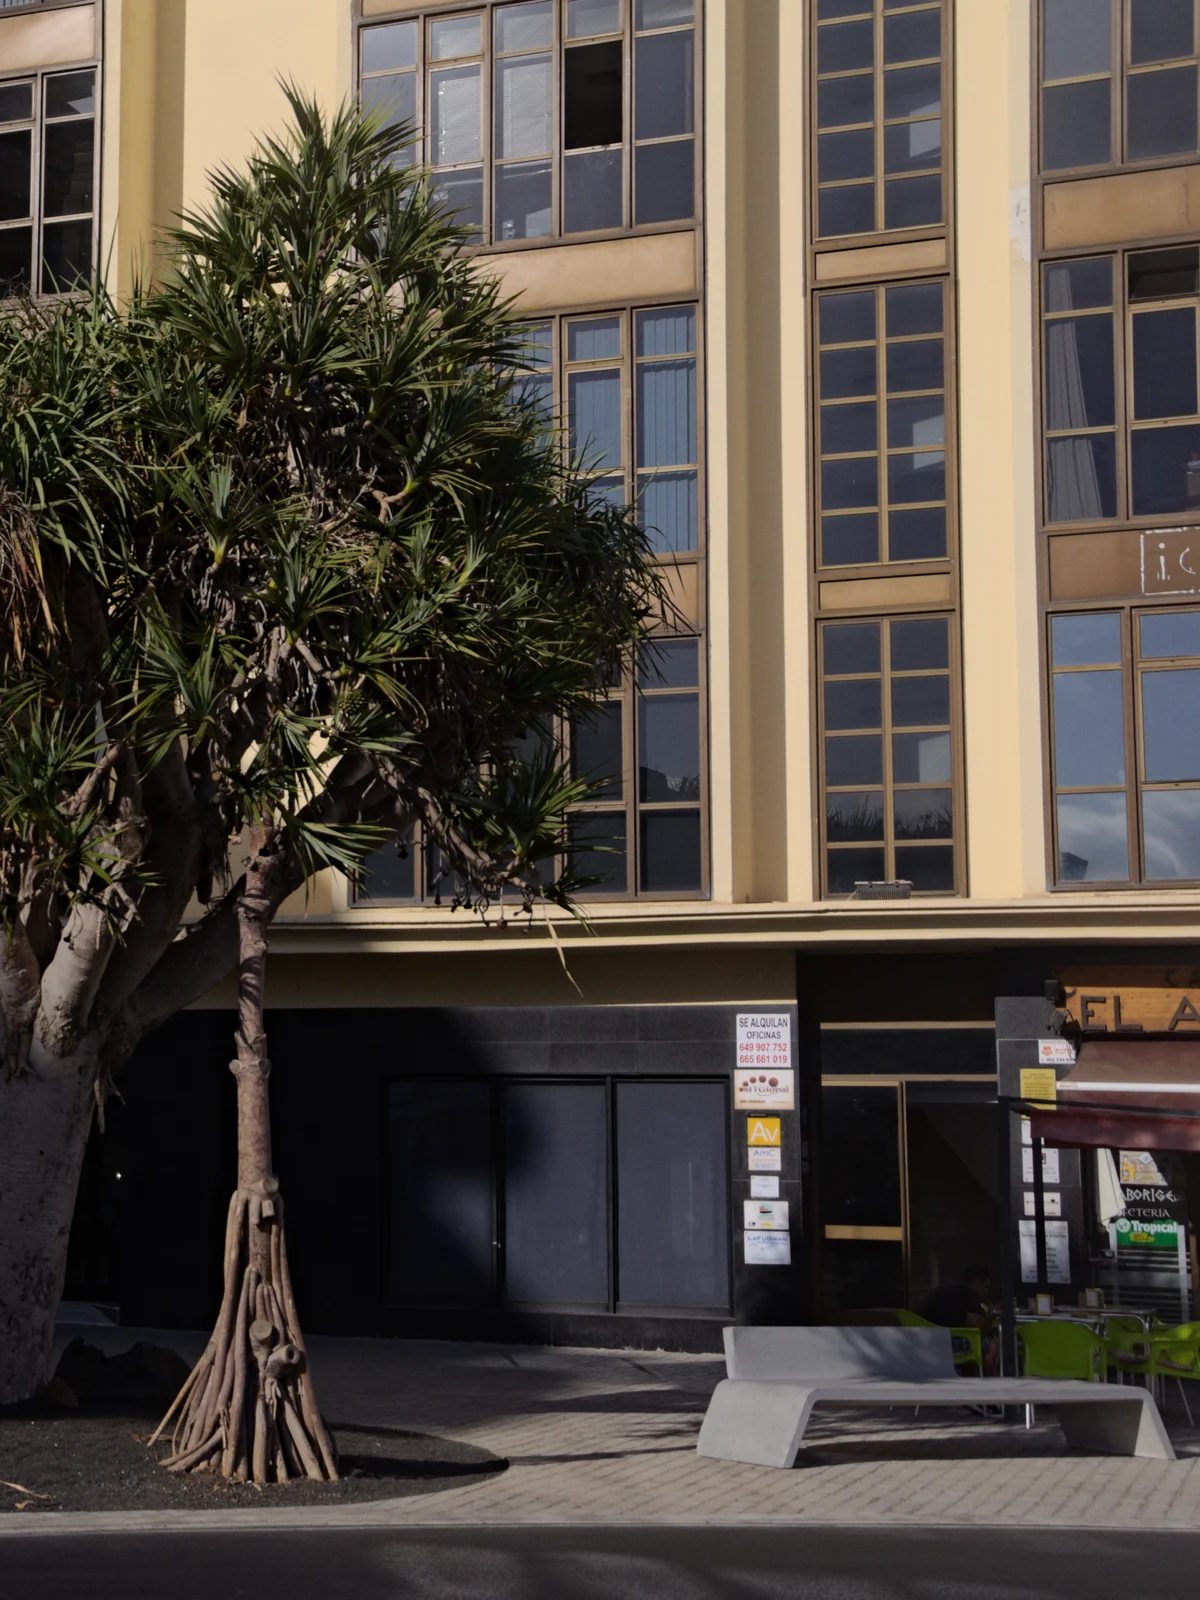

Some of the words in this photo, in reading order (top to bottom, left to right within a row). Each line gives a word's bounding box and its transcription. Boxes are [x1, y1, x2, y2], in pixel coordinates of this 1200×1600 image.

[1081, 995, 1144, 1032] EL
[739, 1017, 749, 1028] SE
[751, 1017, 788, 1028] ALQUILAN
[746, 1031, 782, 1040] OFICINAS
[739, 1043, 754, 1051] 649
[756, 1043, 770, 1051] 907
[773, 1043, 788, 1051] 752
[739, 1055, 754, 1063] 665
[756, 1055, 770, 1063] 661
[773, 1055, 788, 1063] 019
[750, 1121, 779, 1143] Av
[753, 1149, 776, 1157] AmC
[1131, 1219, 1178, 1235] Tropical
